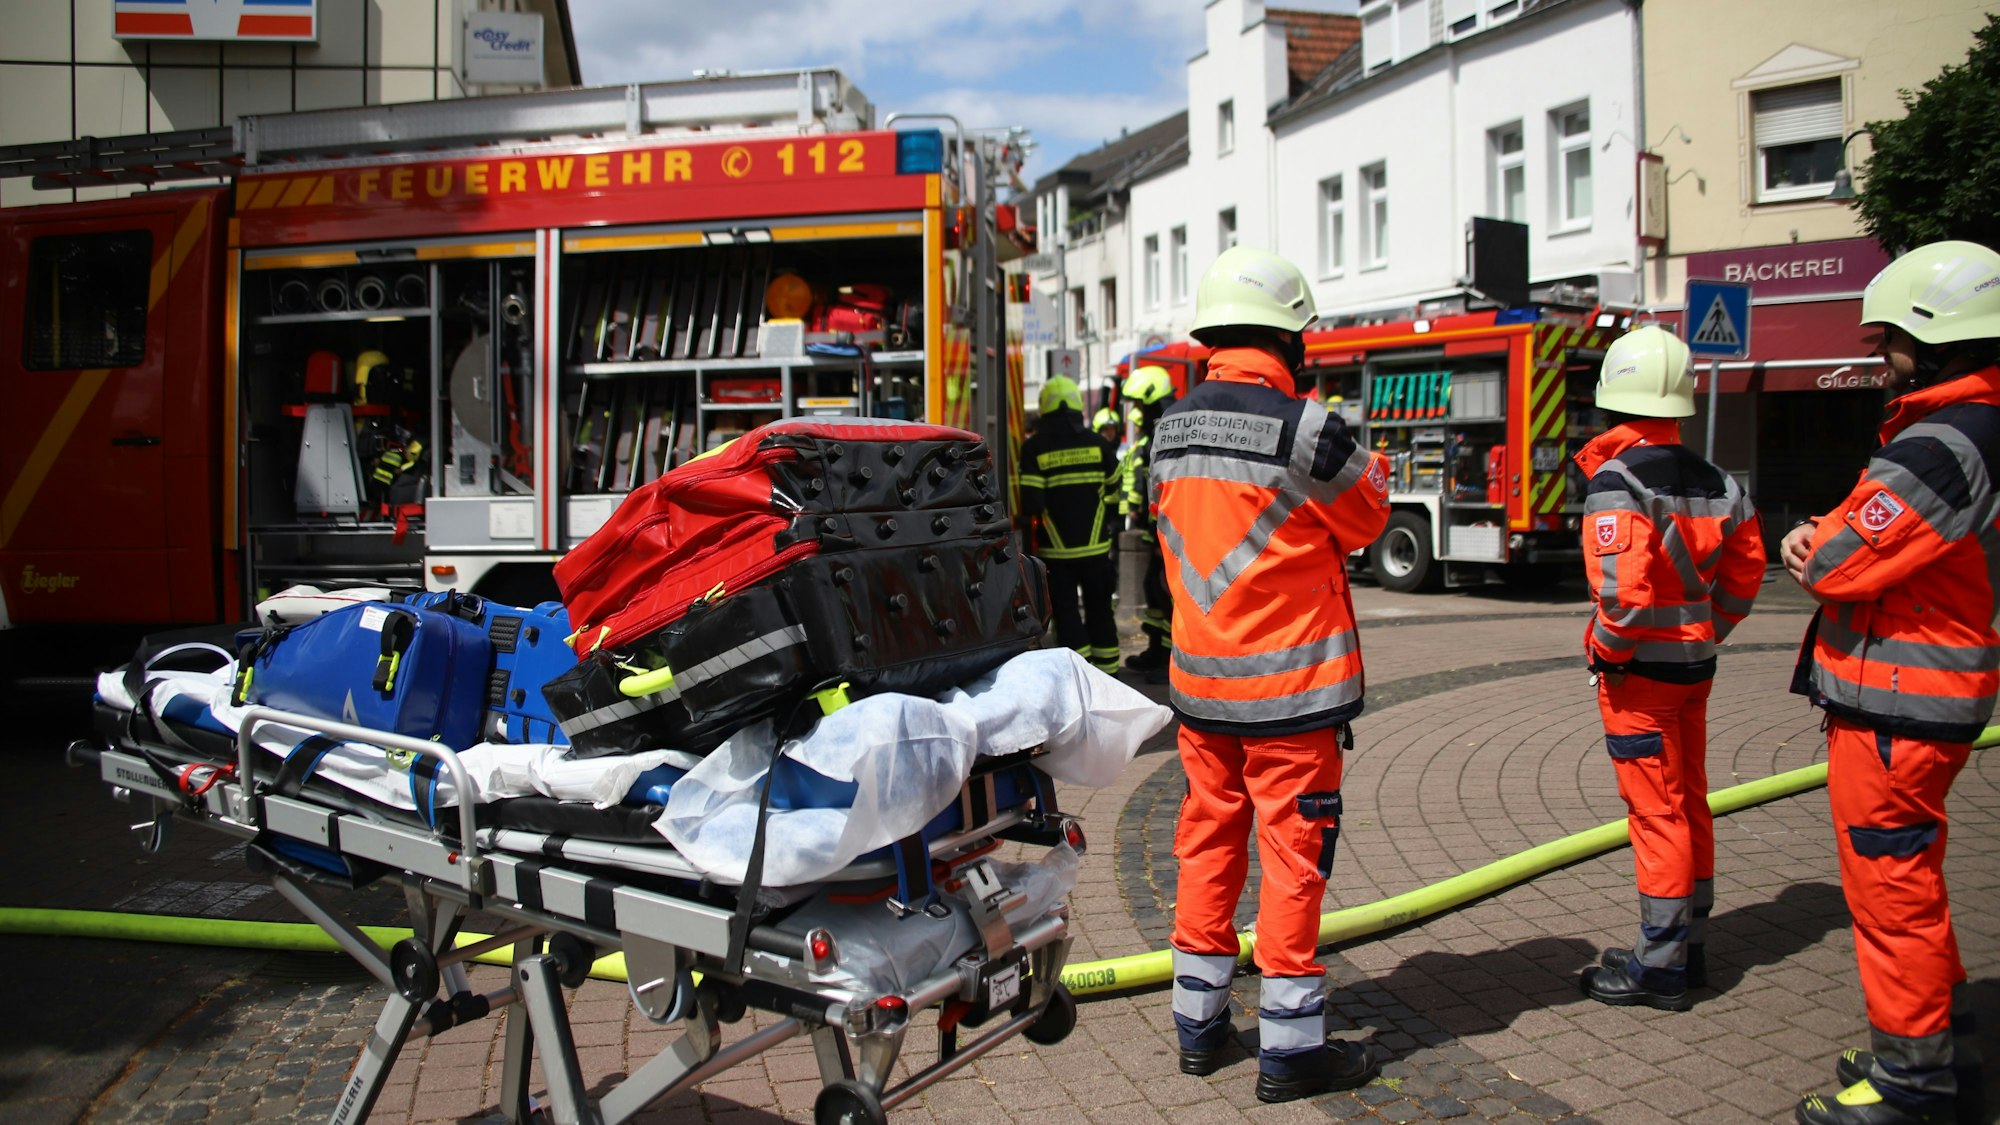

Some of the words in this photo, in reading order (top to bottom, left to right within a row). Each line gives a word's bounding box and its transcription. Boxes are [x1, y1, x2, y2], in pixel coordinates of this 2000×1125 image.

[358, 149, 692, 203] FEUERWEHR
[777, 138, 865, 177] 112
[1724, 257, 1844, 282] BÄCKEREI
[22, 565, 80, 594] Ziegler
